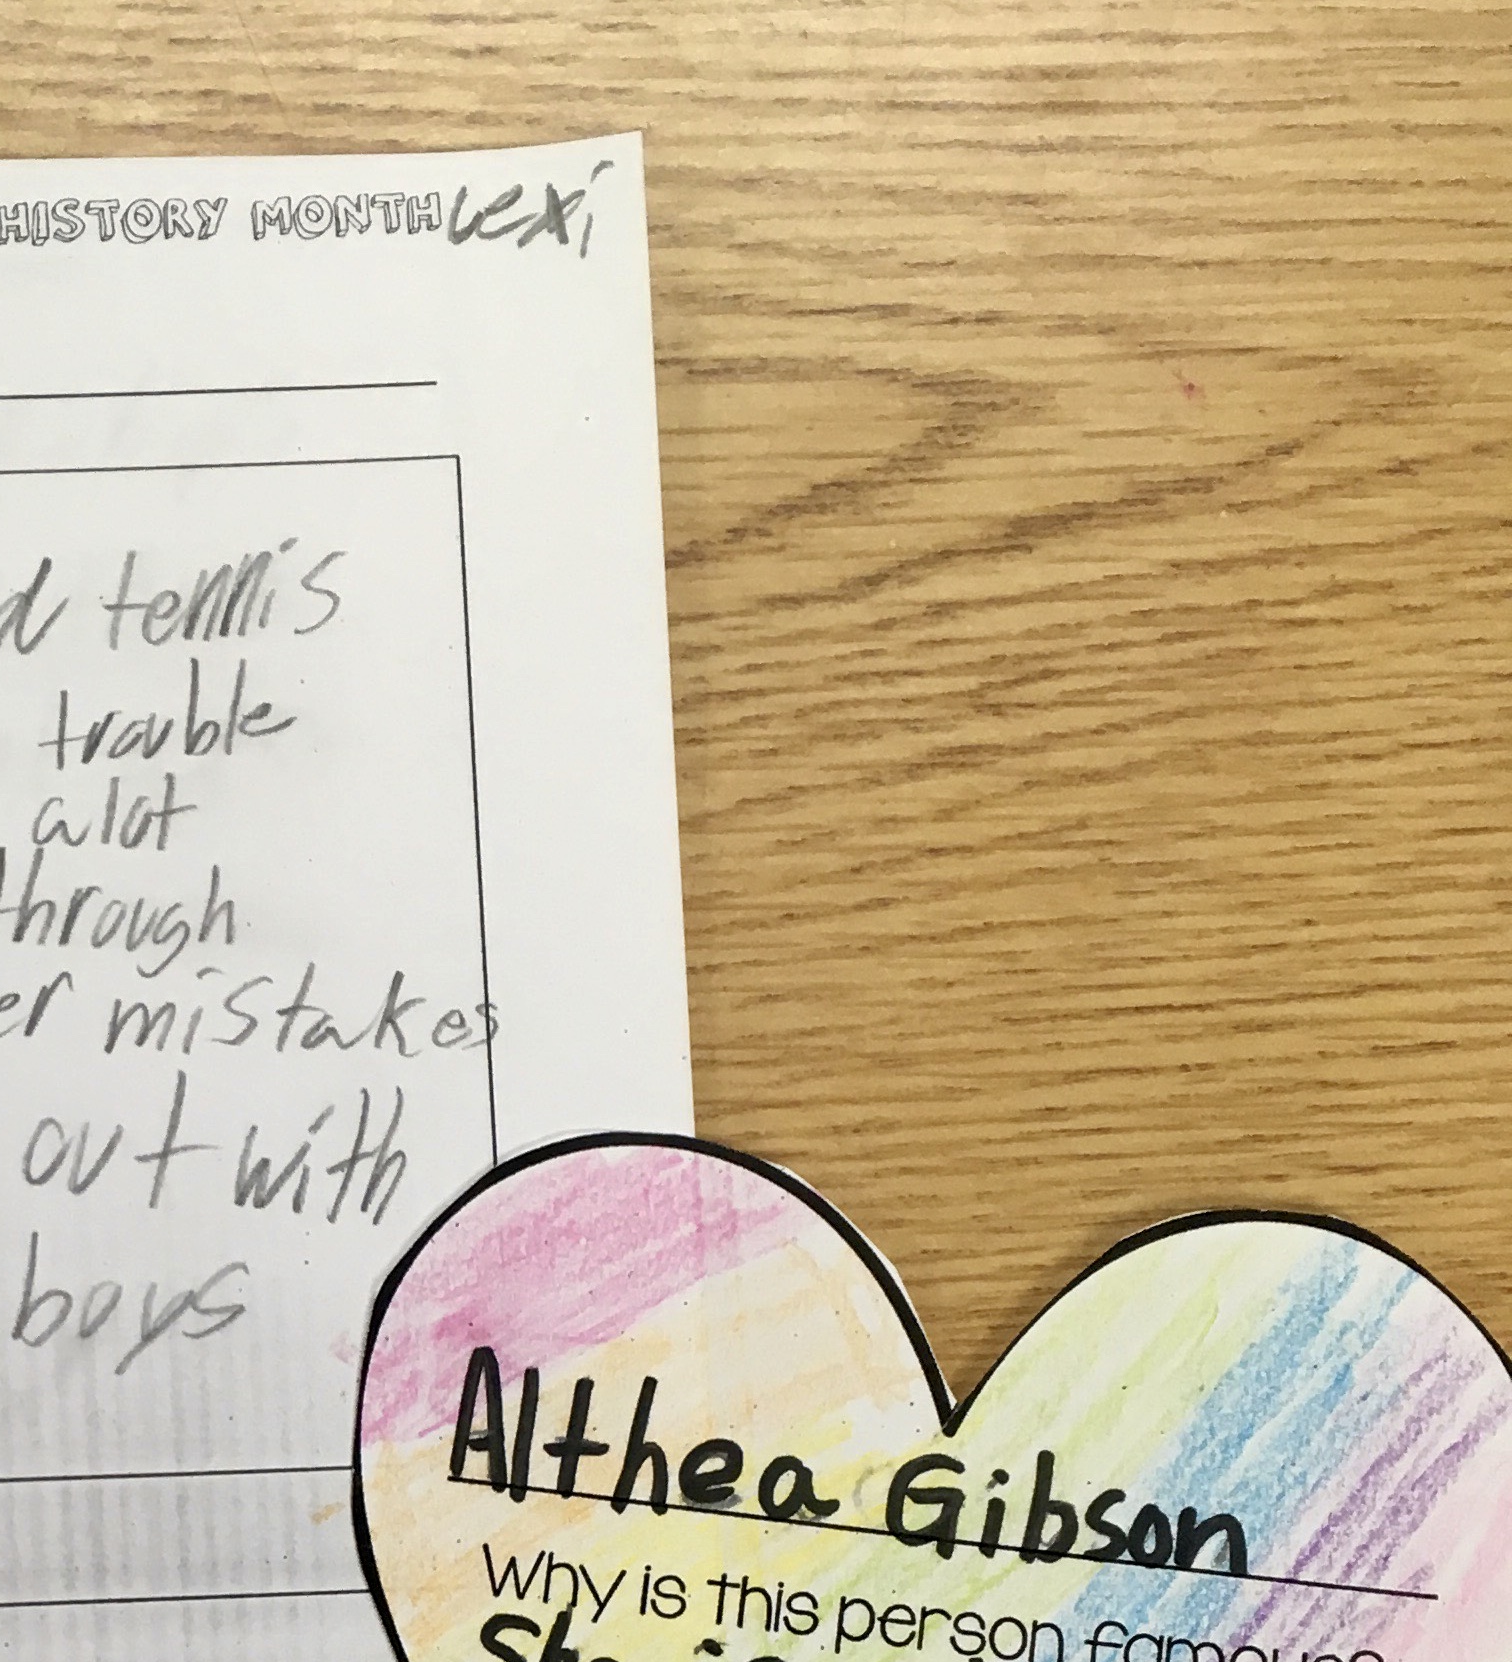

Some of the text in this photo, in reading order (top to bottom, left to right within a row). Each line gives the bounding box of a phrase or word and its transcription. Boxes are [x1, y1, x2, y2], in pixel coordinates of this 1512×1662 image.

[250, 192, 442, 238] MONTH
[102, 540, 348, 648] tennis
[21, 1070, 214, 1210] out
[235, 1086, 408, 1226] with
[450, 1346, 838, 1520] Althea
[483, 1543, 626, 1624] Why
[640, 1565, 686, 1622] is
[708, 1573, 820, 1640] this
